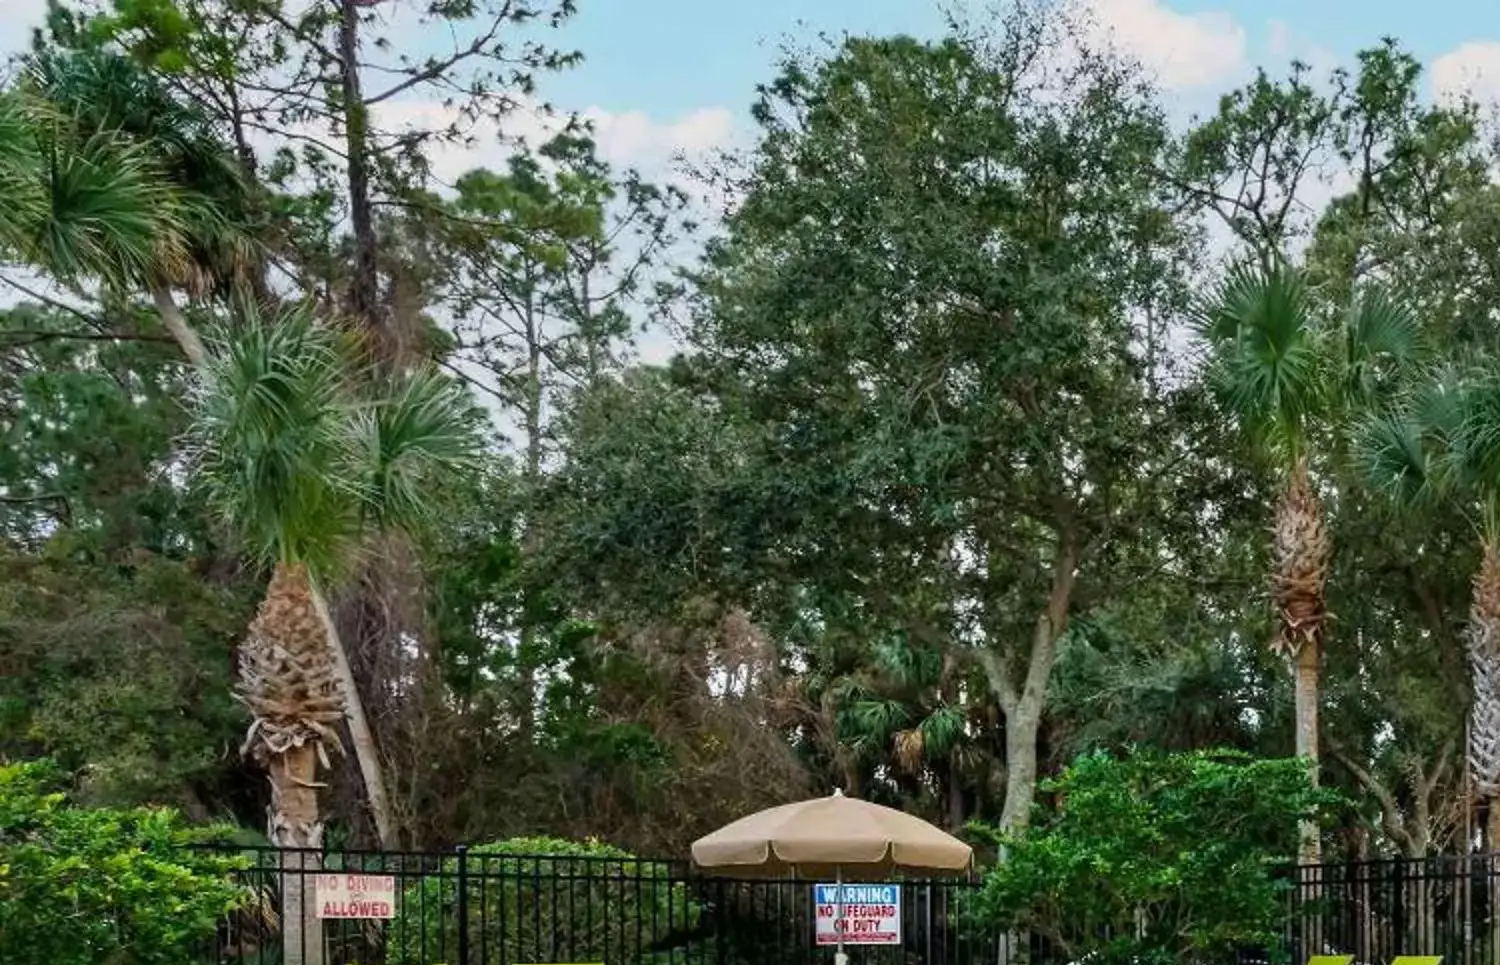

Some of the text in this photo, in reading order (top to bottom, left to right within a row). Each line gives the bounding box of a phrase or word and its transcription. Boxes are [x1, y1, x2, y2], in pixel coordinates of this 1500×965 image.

[323, 901, 389, 916] ALLOWED
[819, 905, 833, 917] NO
[854, 920, 881, 931] DUTY
